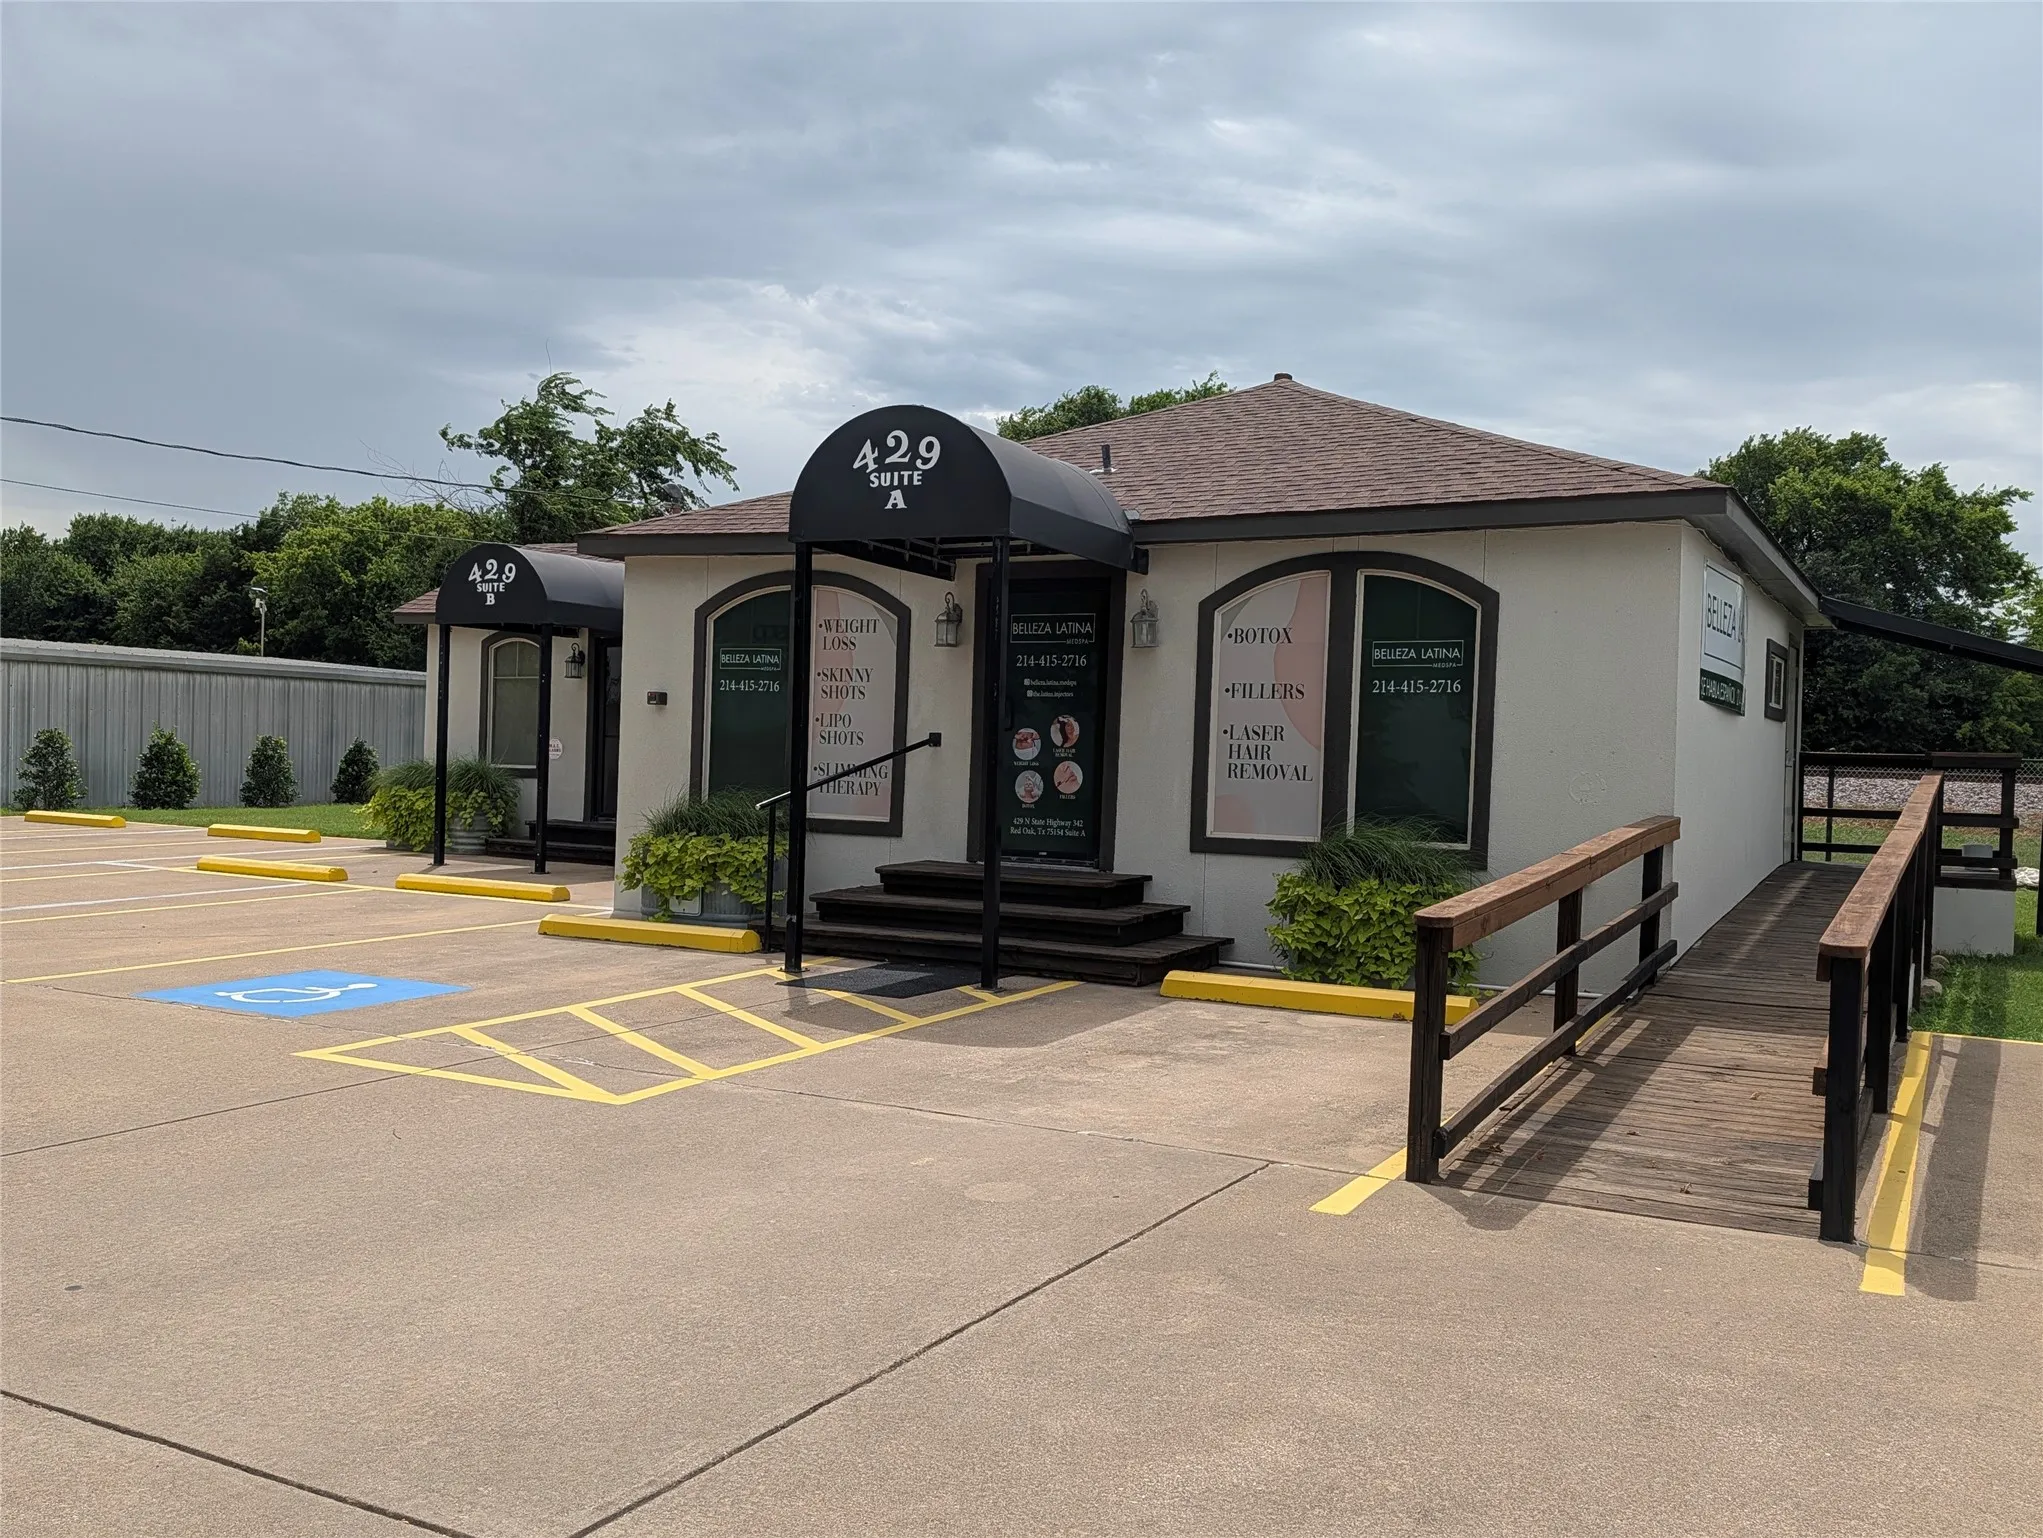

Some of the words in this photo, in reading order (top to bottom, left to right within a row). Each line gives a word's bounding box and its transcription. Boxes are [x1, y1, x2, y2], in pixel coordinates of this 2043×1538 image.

[852, 429, 941, 473] 429
[869, 471, 923, 488] SUITE
[884, 489, 908, 509] A
[468, 559, 516, 583] 429
[476, 582, 506, 592] SUITE
[485, 594, 495, 605] B
[1707, 592, 1736, 641] BELLEZA
[822, 618, 880, 634] WEIGHT
[1012, 622, 1052, 635] BELLEZA
[1056, 622, 1093, 634] LATINA
[823, 636, 857, 651] LOSS
[1233, 627, 1294, 644] BOTOX
[721, 654, 750, 664] BELLEZA
[752, 654, 780, 664] LATINA
[1016, 654, 1087, 667] 214-415-2716
[1374, 648, 1416, 659] BELLEZA
[1421, 648, 1461, 659] LATINA
[821, 667, 874, 683] SKINNY
[719, 679, 780, 692] 214-415-2716
[820, 685, 866, 700] SHOTS
[1231, 682, 1305, 700] FILLERS
[1372, 679, 1461, 693] 214-415-2716
[820, 713, 852, 729] LIPO
[819, 730, 864, 746] SHOTS
[1229, 724, 1285, 741] LASER
[1228, 744, 1271, 760] HAIR
[1227, 763, 1314, 782] REMOVAL
[1013, 817, 1023, 825] 429
[1024, 817, 1030, 825] N
[1031, 818, 1045, 826] State
[1046, 818, 1071, 828] Highway
[1073, 819, 1084, 827] 342
[1010, 826, 1021, 834] Red
[1047, 828, 1063, 836] 75154
[1065, 829, 1079, 837] Suite
